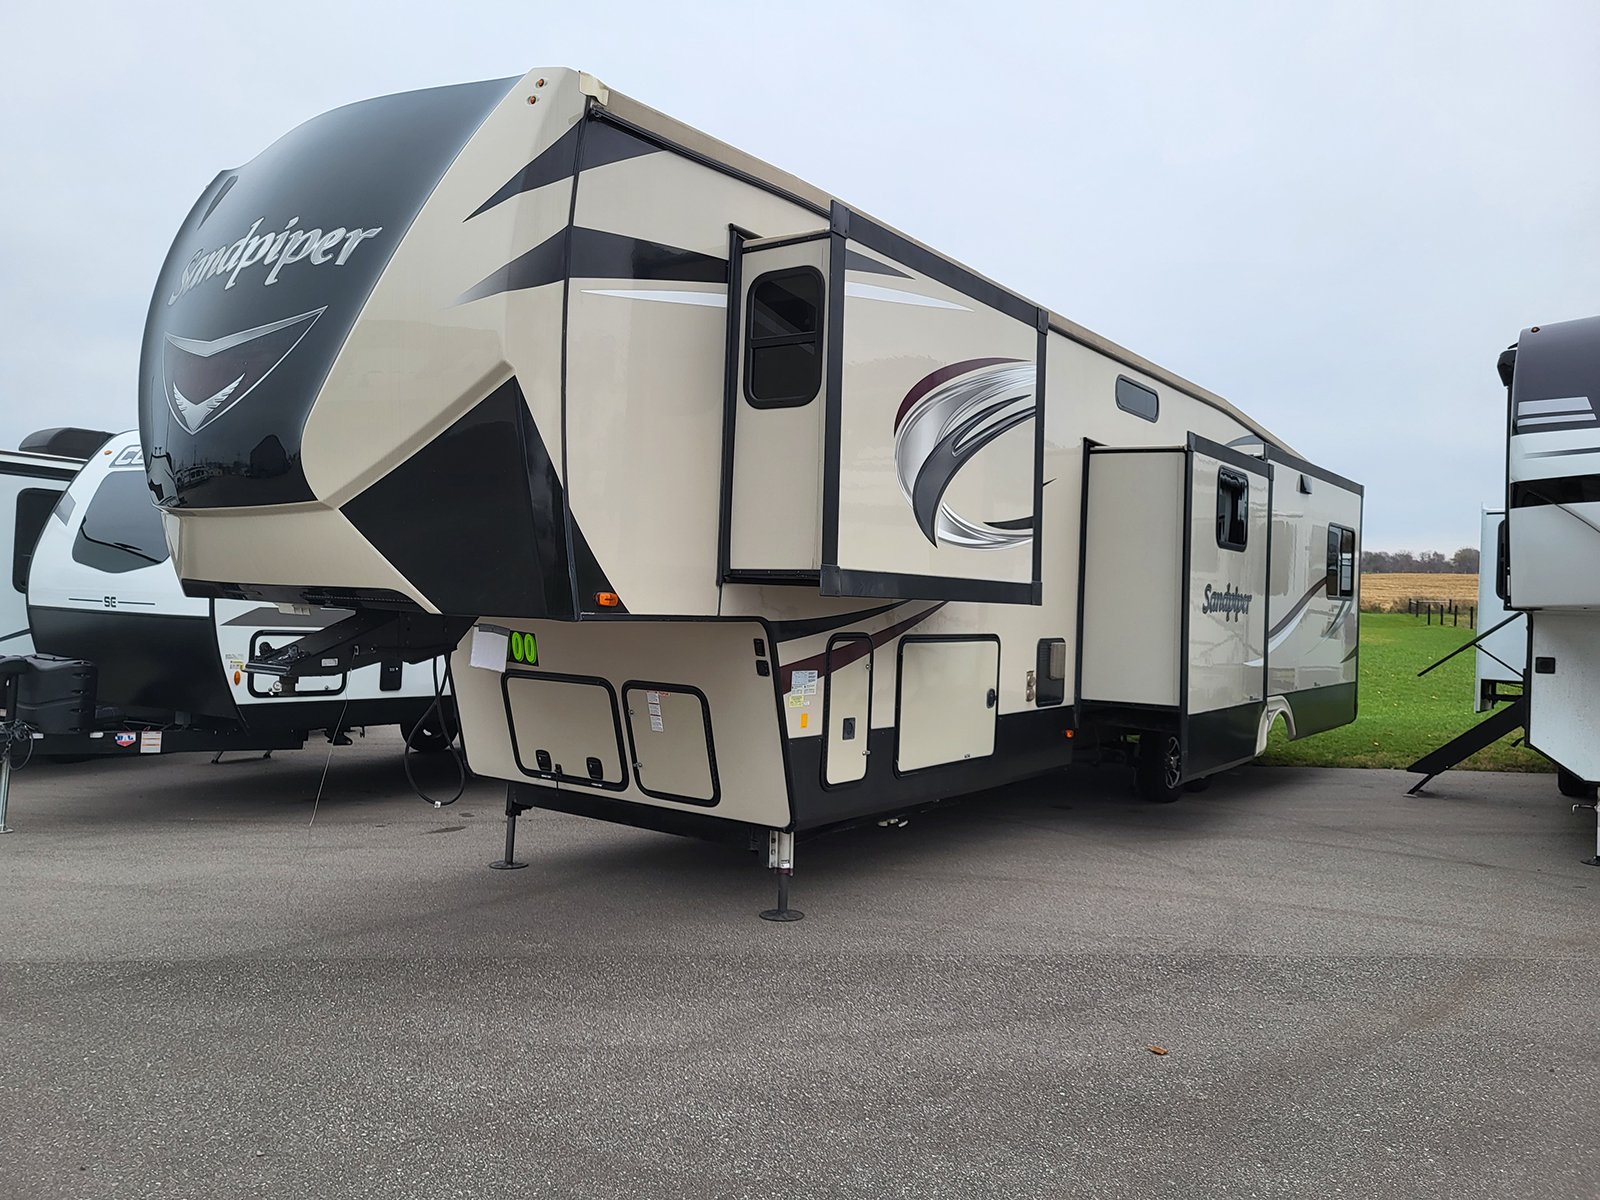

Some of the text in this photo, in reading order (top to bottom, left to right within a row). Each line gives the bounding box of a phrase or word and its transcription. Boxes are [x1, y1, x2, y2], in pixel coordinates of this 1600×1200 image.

[167, 215, 383, 306] Sandpiper
[104, 595, 117, 608] SE
[1202, 582, 1252, 623] Sandpiper
[508, 631, 537, 664] 00
